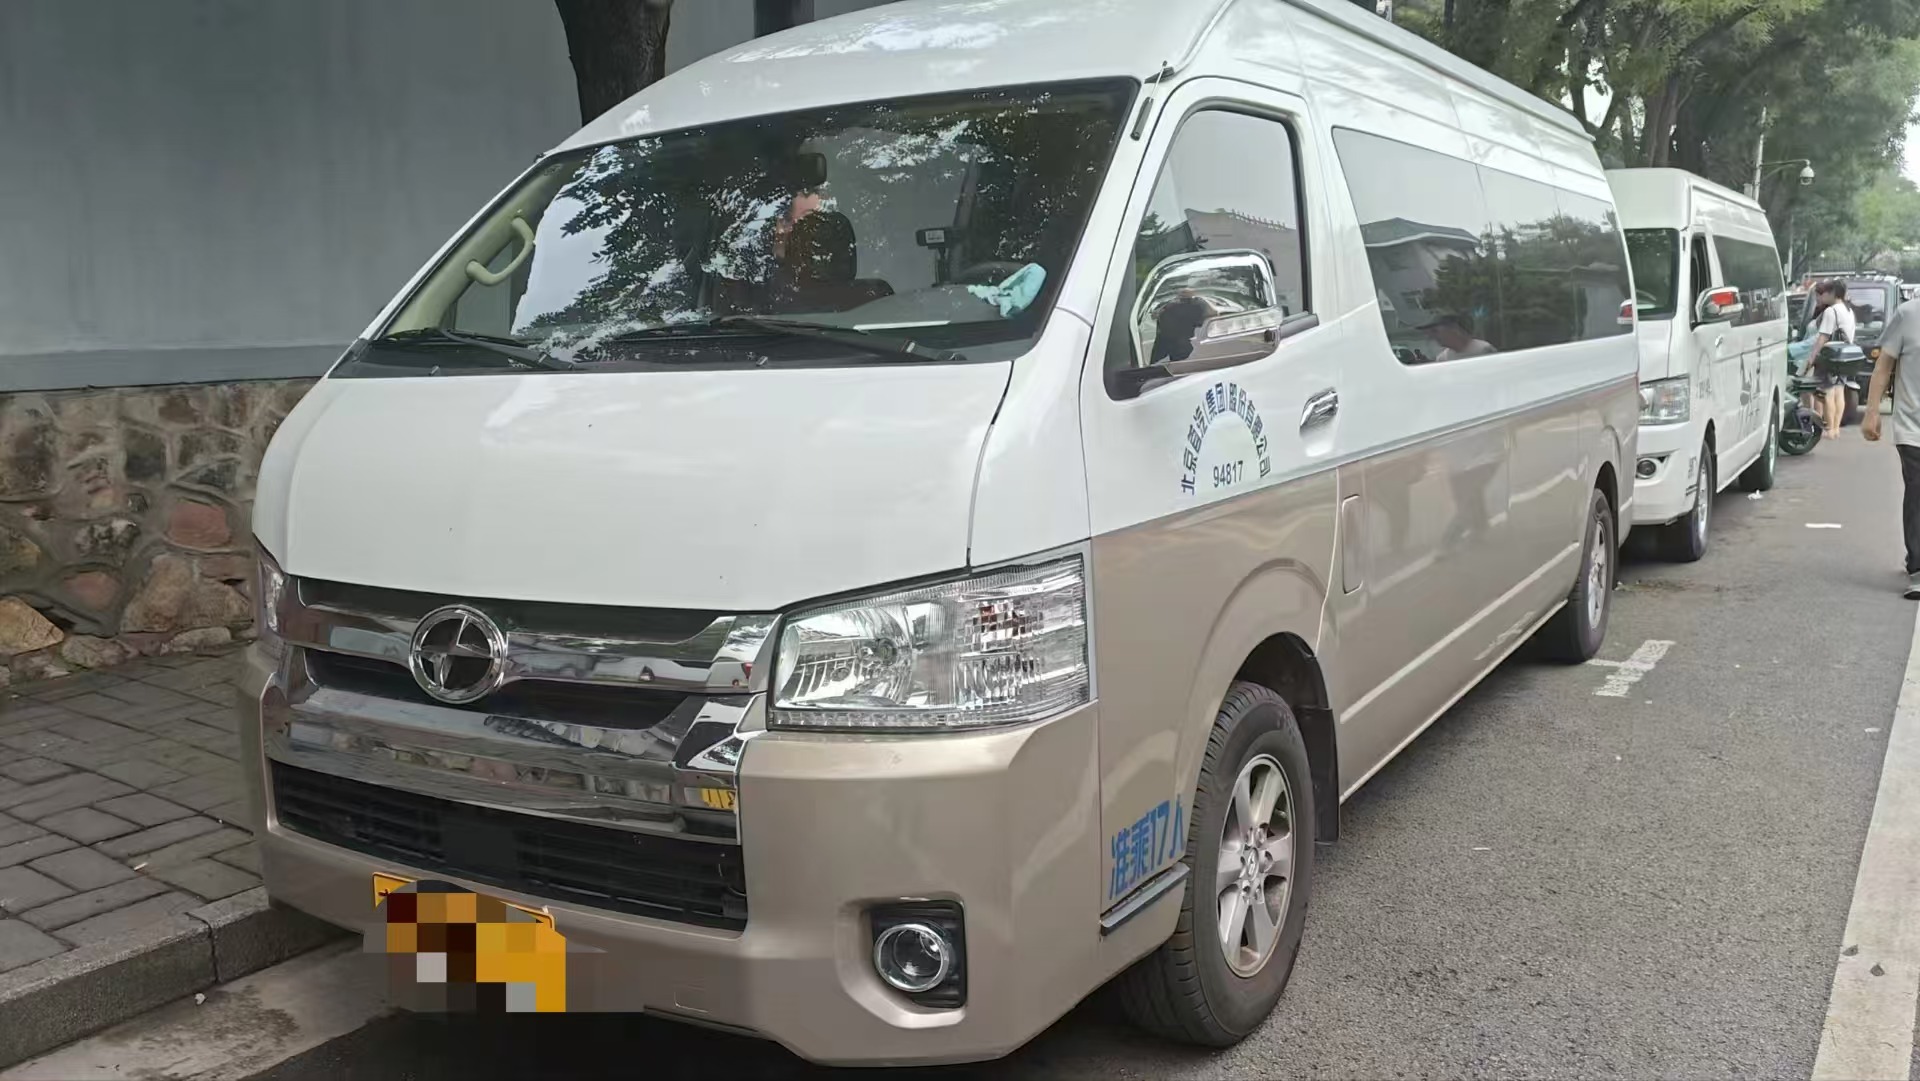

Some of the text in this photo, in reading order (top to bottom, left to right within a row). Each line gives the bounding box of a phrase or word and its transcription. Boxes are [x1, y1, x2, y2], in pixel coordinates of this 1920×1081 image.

[1213, 460, 1243, 488] 94817
[1110, 794, 1184, 900] 准乘17人
